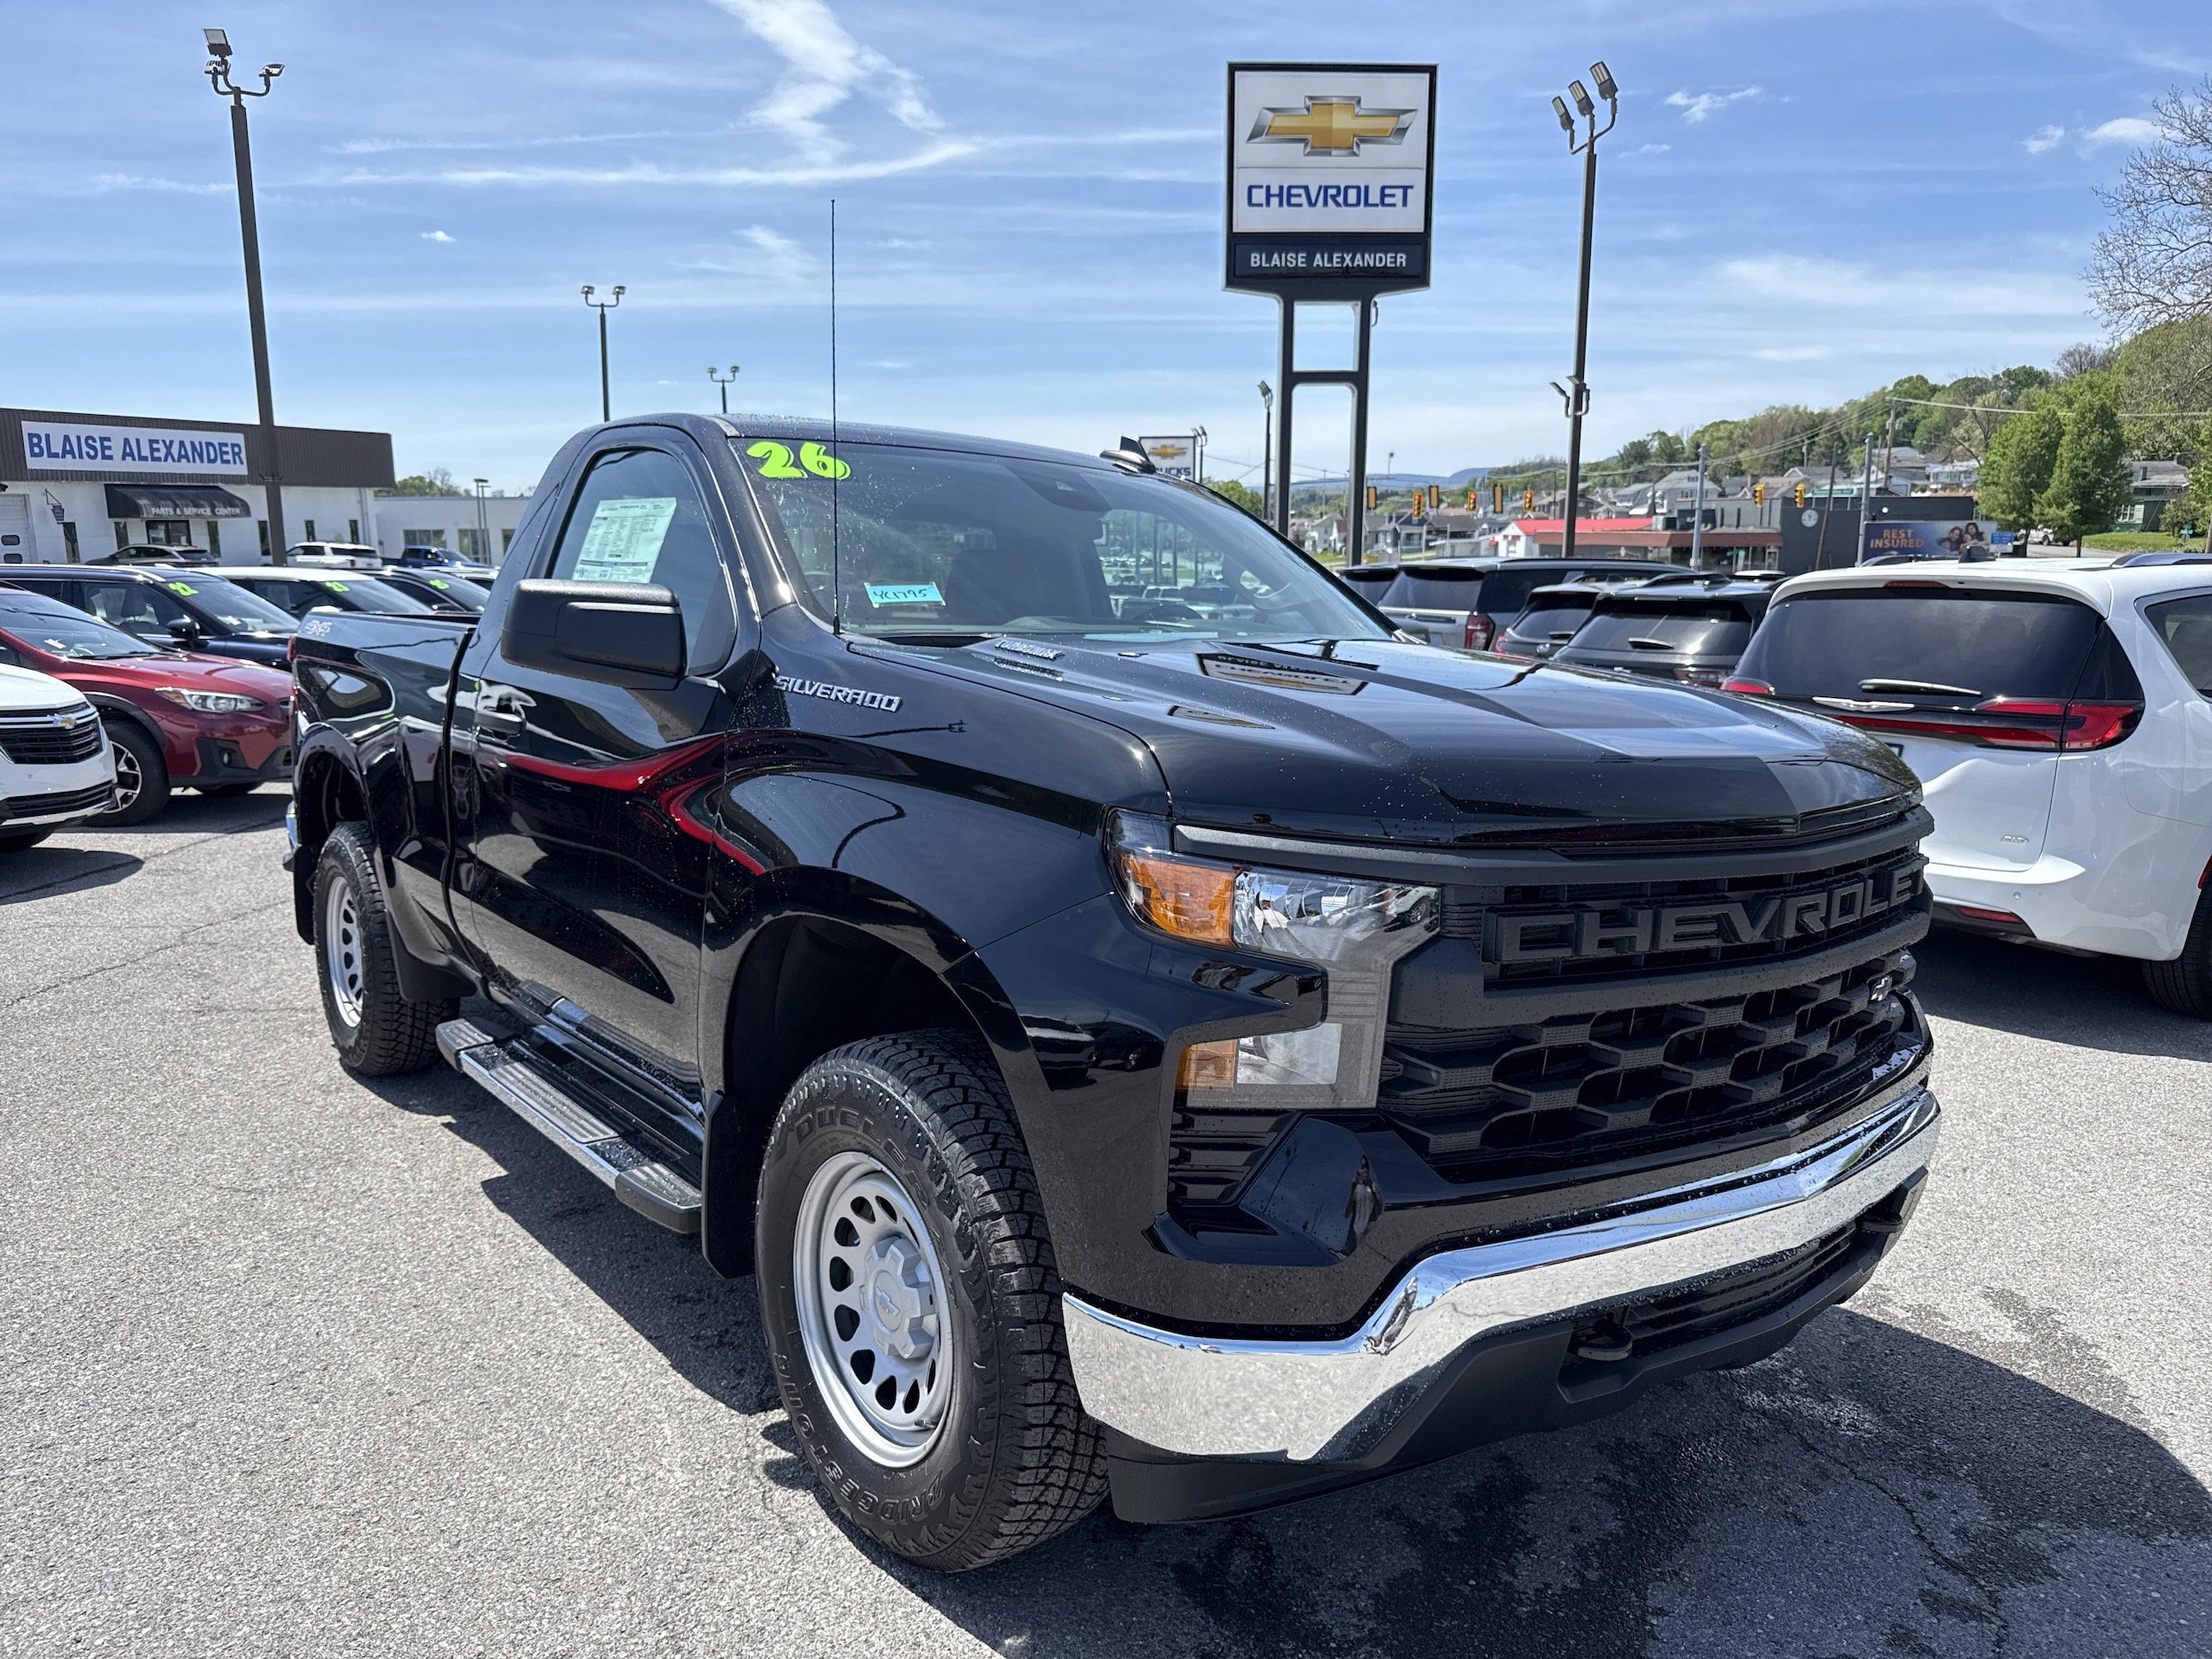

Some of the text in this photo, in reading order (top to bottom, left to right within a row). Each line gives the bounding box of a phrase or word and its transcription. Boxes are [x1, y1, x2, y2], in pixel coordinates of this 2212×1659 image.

[1247, 184, 1414, 208] CHEVROLET
[1250, 253, 1407, 267] BLAISE ALEXANDER
[27, 433, 244, 465] BLAISE ALEXANDER
[747, 442, 851, 480] 26
[151, 507, 241, 516] PARTS & SERVICE CENTER
[1870, 538, 1924, 549] INSURED
[1883, 529, 1912, 539] REST
[774, 675, 903, 713] SILVERADO
[1486, 856, 1929, 963] CHEVROLET
